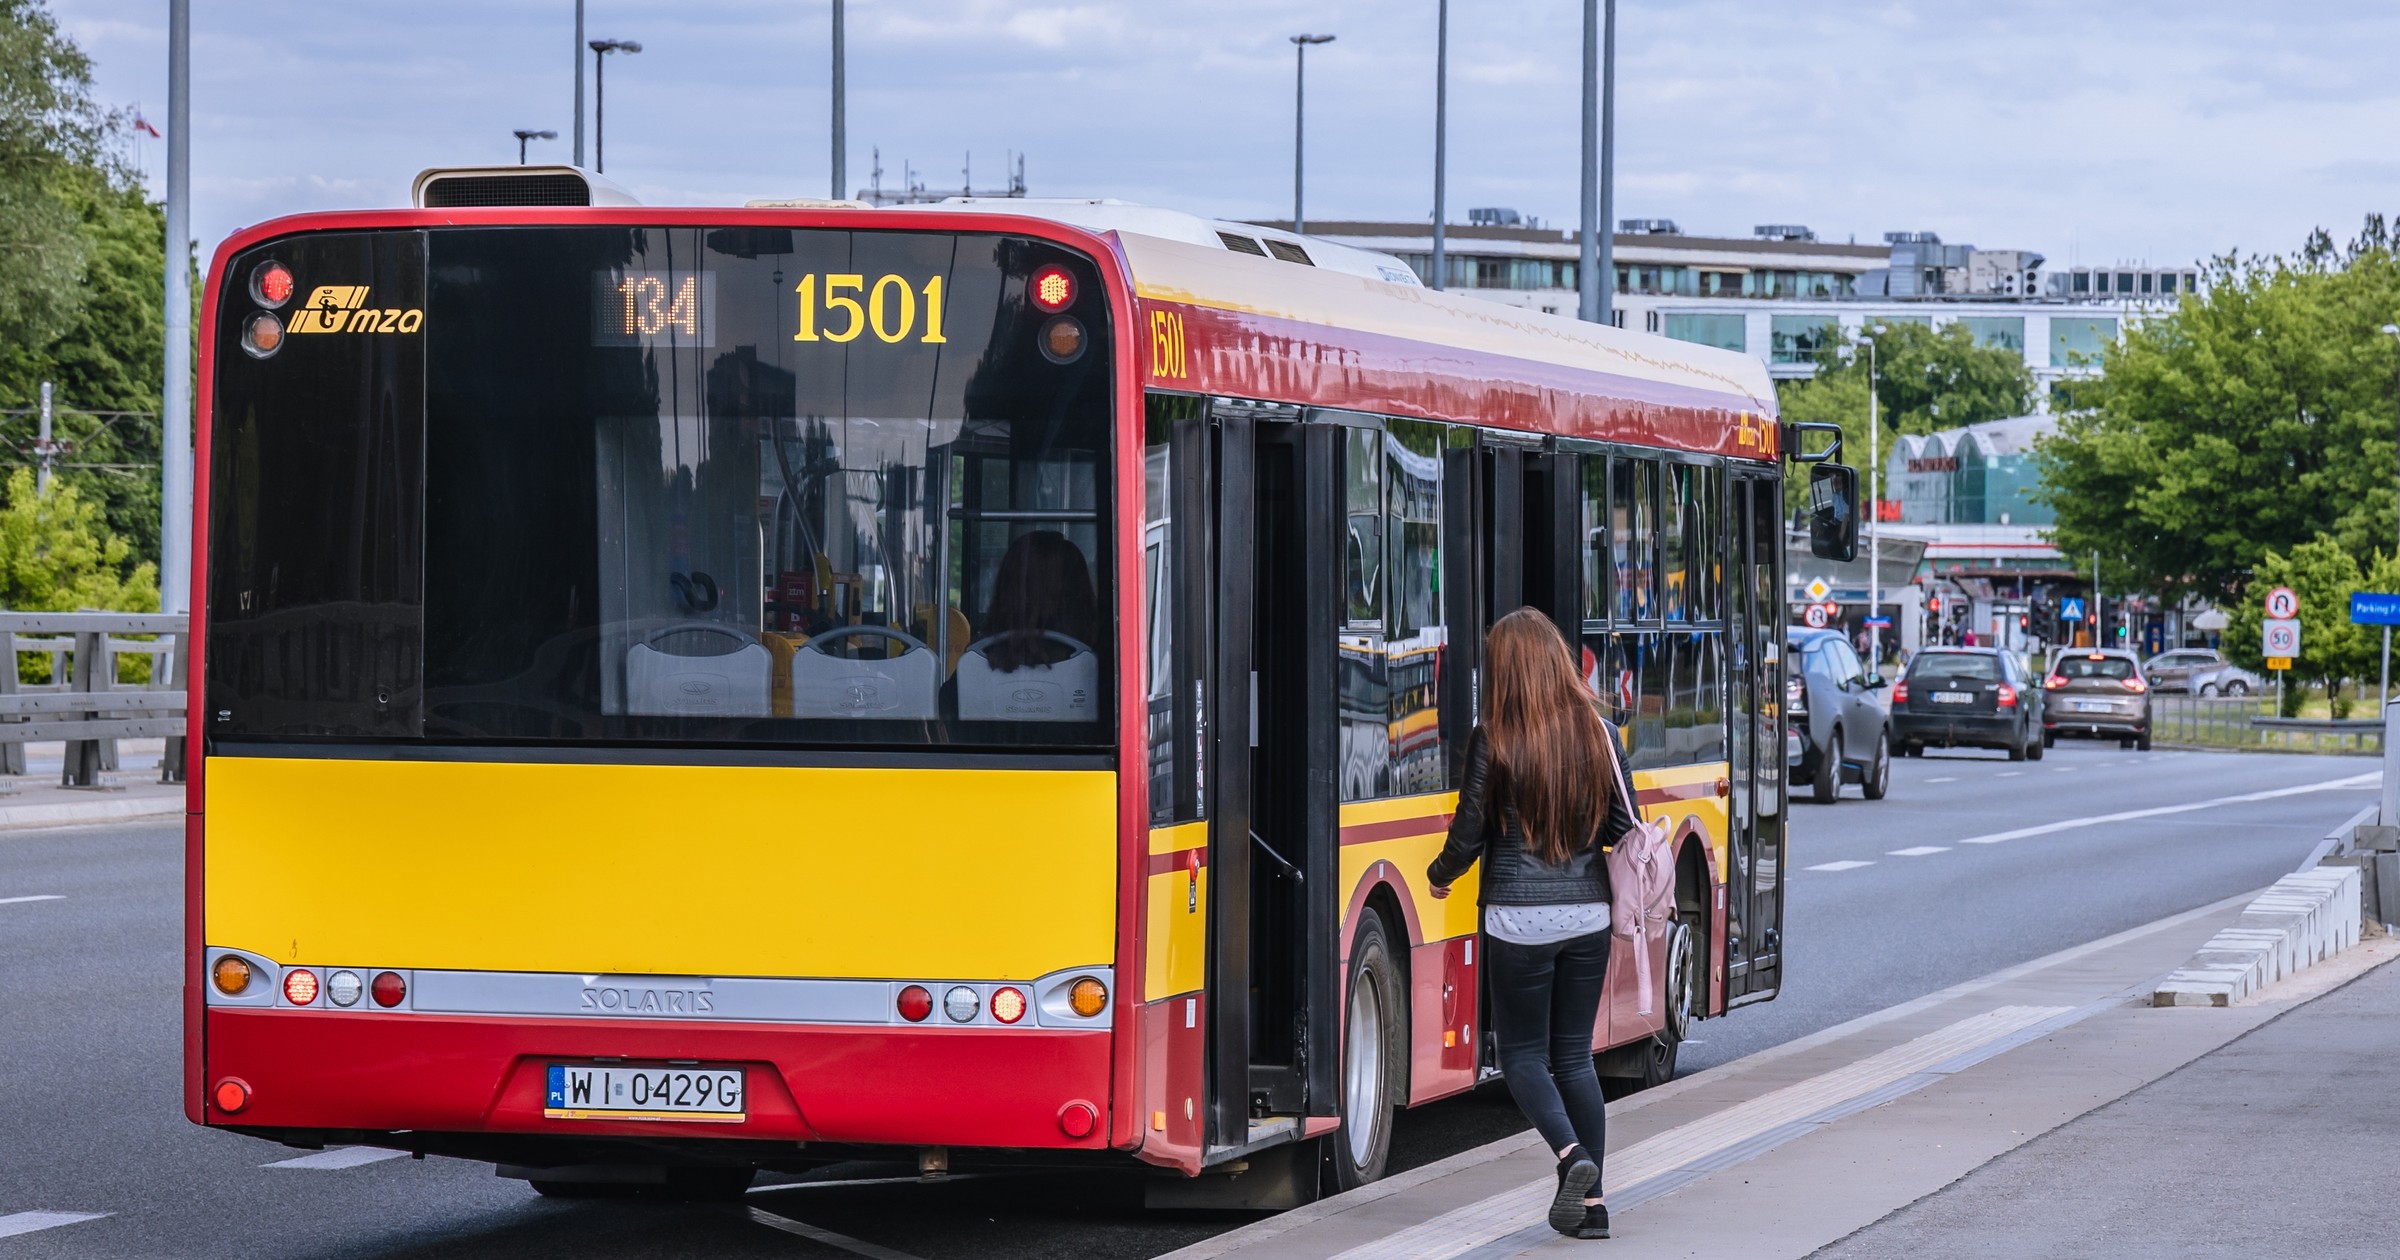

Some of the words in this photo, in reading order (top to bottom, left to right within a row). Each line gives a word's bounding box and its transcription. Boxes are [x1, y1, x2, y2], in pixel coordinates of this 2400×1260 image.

[619, 277, 695, 335] 134
[793, 273, 947, 344] 1501
[346, 308, 424, 334] mza
[1150, 310, 1187, 379] 1501
[2356, 603, 2389, 616] Parking
[2273, 632, 2290, 645] 50
[581, 988, 714, 1014] SOLARIS
[551, 1091, 563, 1101] PL
[571, 1071, 610, 1104] WI
[632, 1072, 737, 1107] 0429G
